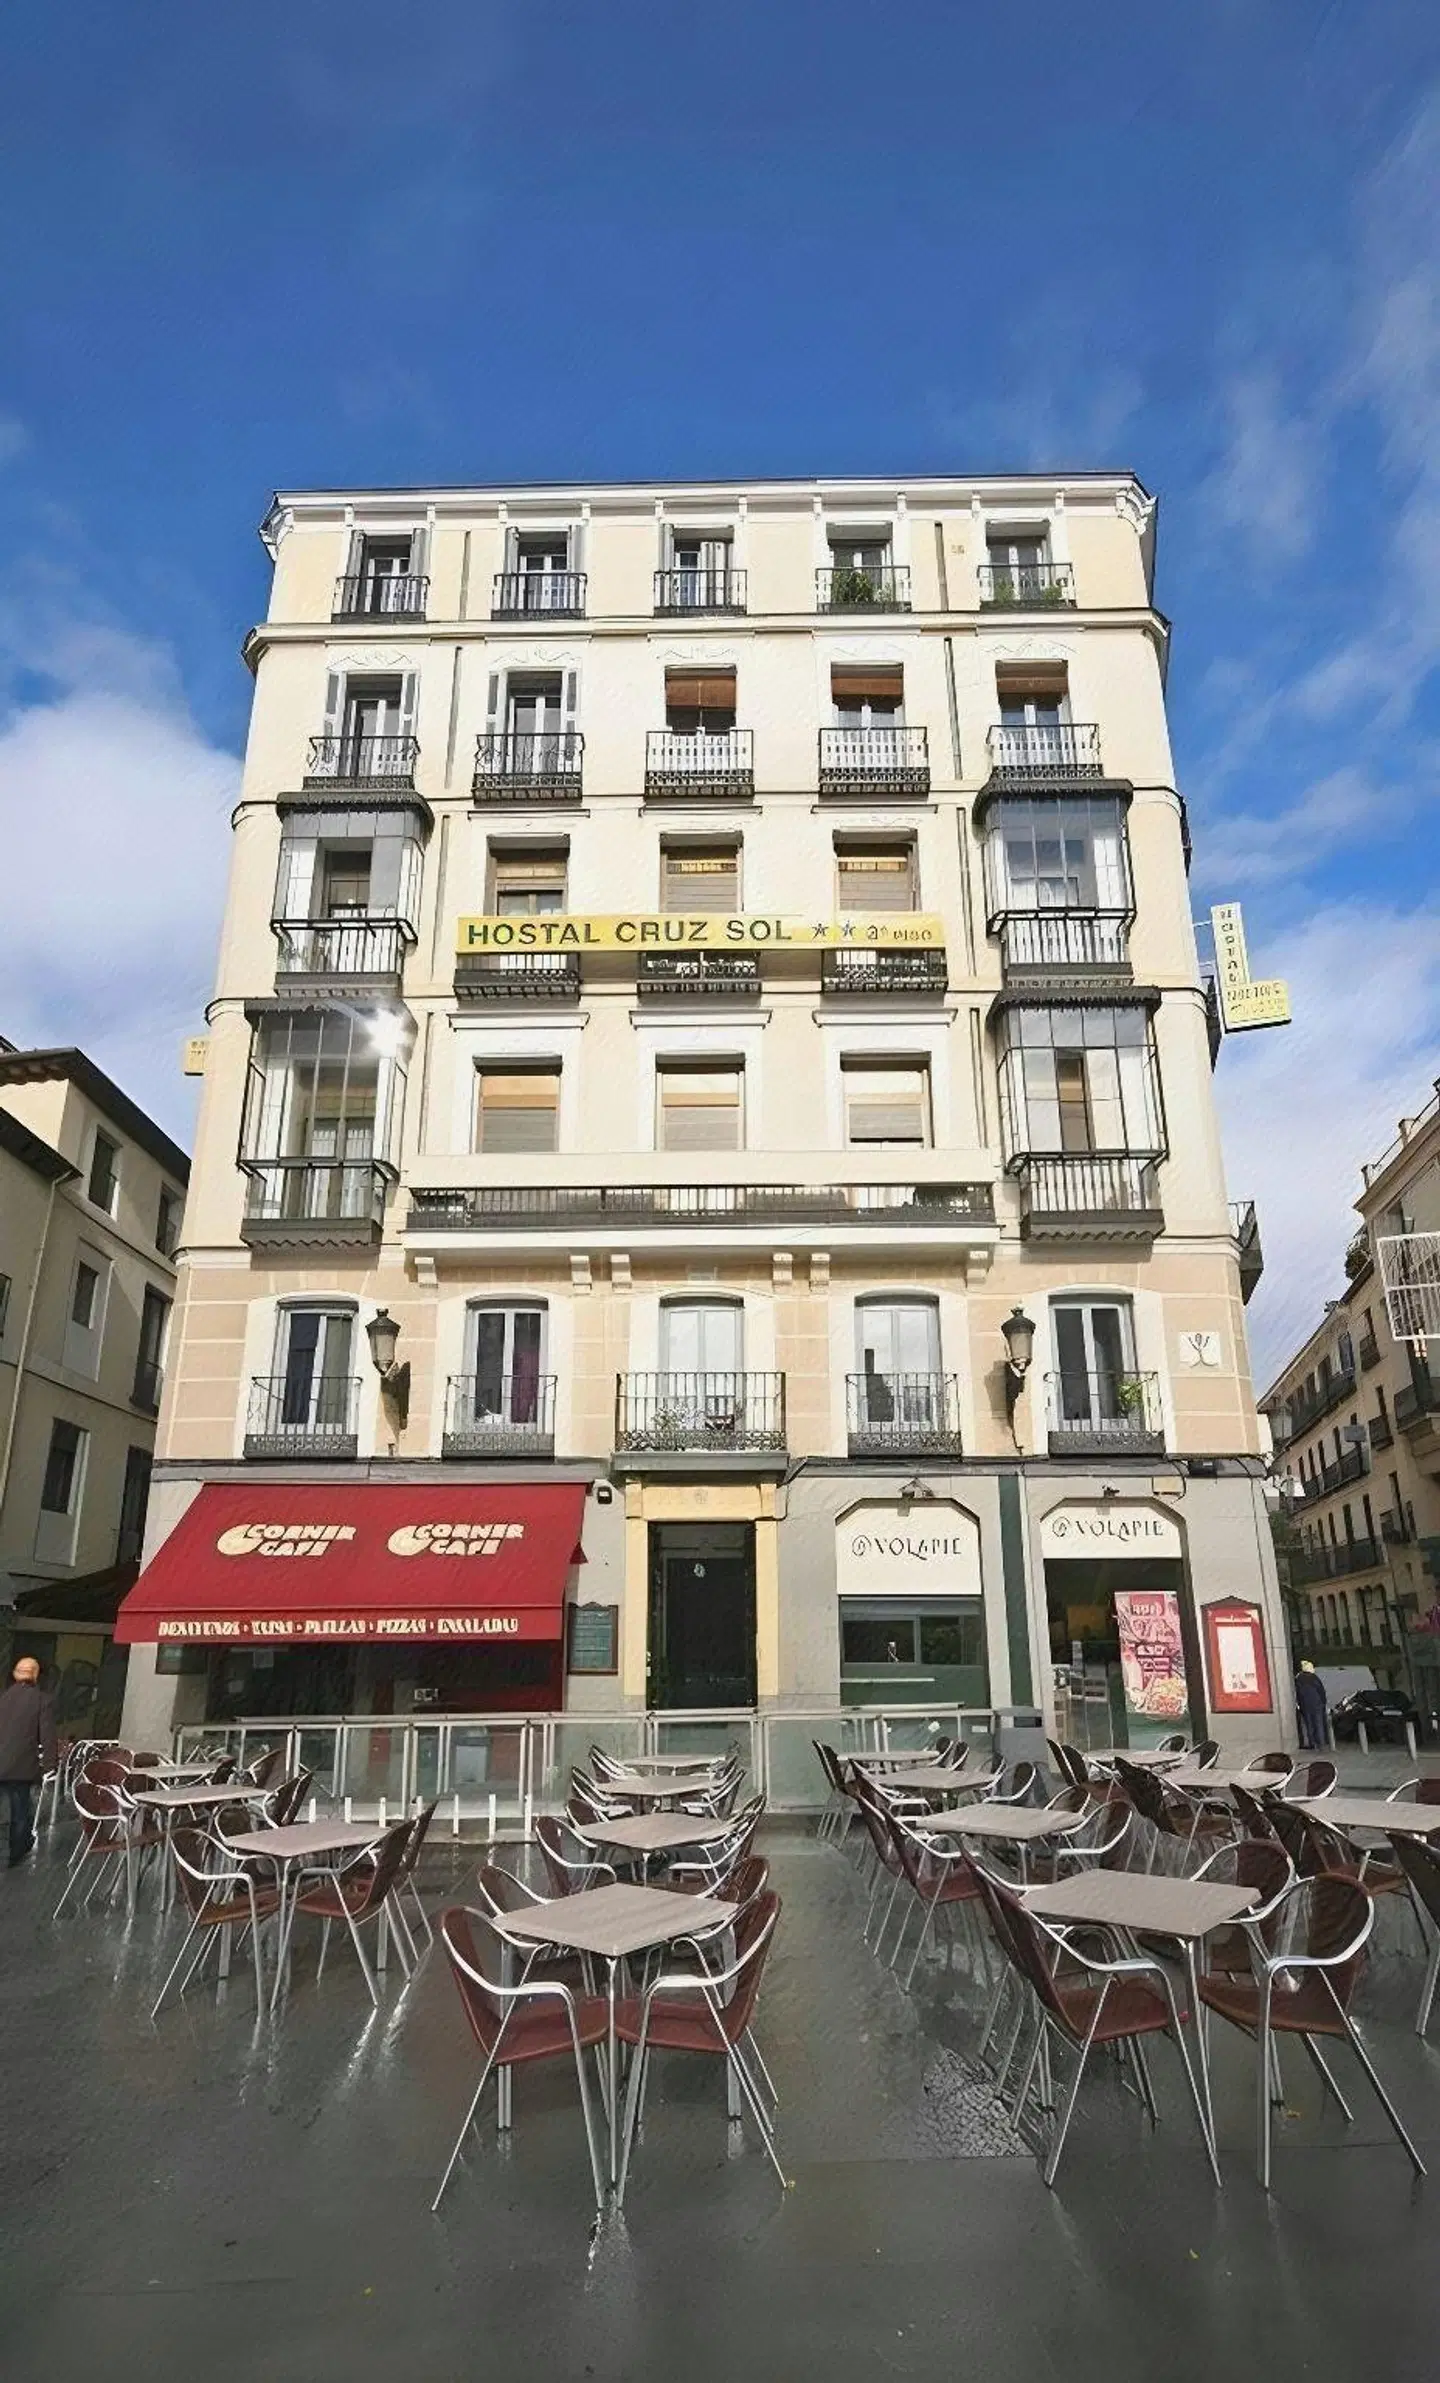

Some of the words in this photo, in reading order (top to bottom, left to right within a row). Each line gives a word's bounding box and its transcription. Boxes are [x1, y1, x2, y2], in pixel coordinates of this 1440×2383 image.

[468, 923, 601, 945] HOSTAL
[615, 921, 708, 942] CRUZ
[726, 920, 792, 941] SOL
[246, 1523, 357, 1540] CORNER
[413, 1523, 525, 1539] CORNER
[376, 1618, 427, 1634] PIZZAS
